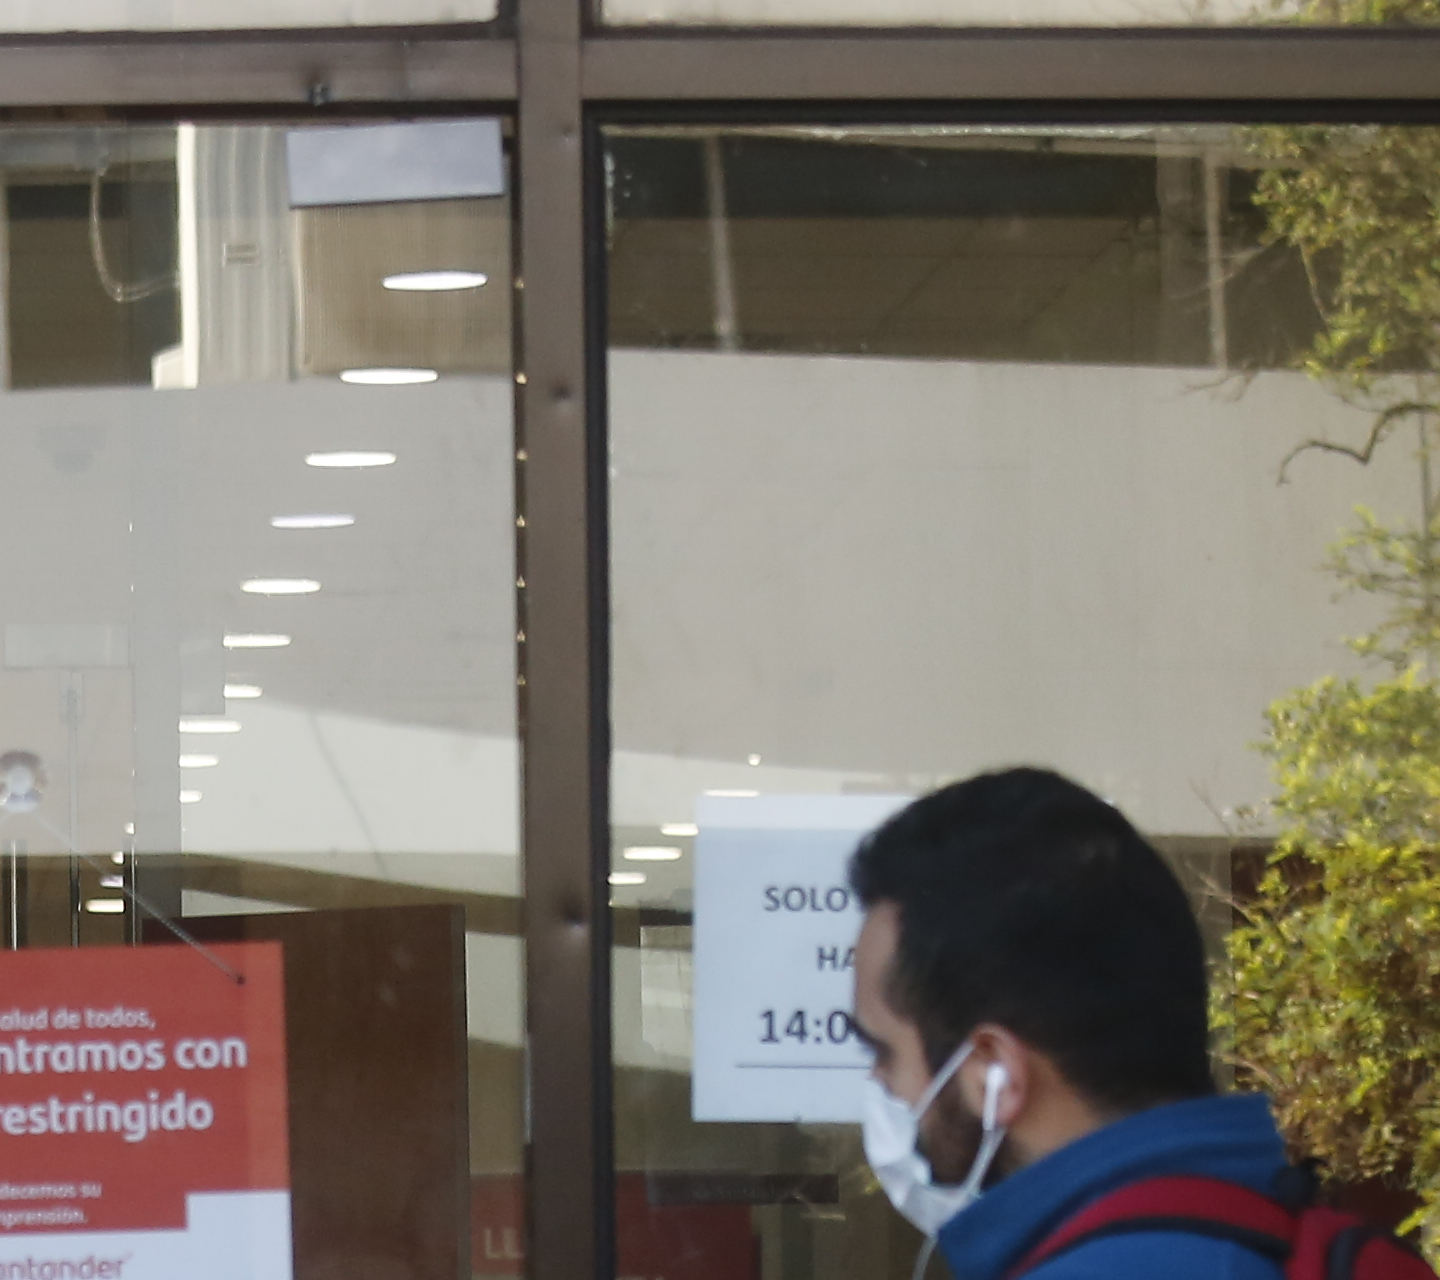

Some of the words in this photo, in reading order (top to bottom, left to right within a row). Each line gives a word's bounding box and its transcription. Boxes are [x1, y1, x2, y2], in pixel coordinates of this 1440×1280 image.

[764, 886, 849, 912] SOLO
[54, 1008, 82, 1031] de
[86, 1006, 156, 1031] todos,
[759, 1008, 852, 1044] 14:0
[174, 1036, 247, 1070] con
[80, 1182, 103, 1198] su
